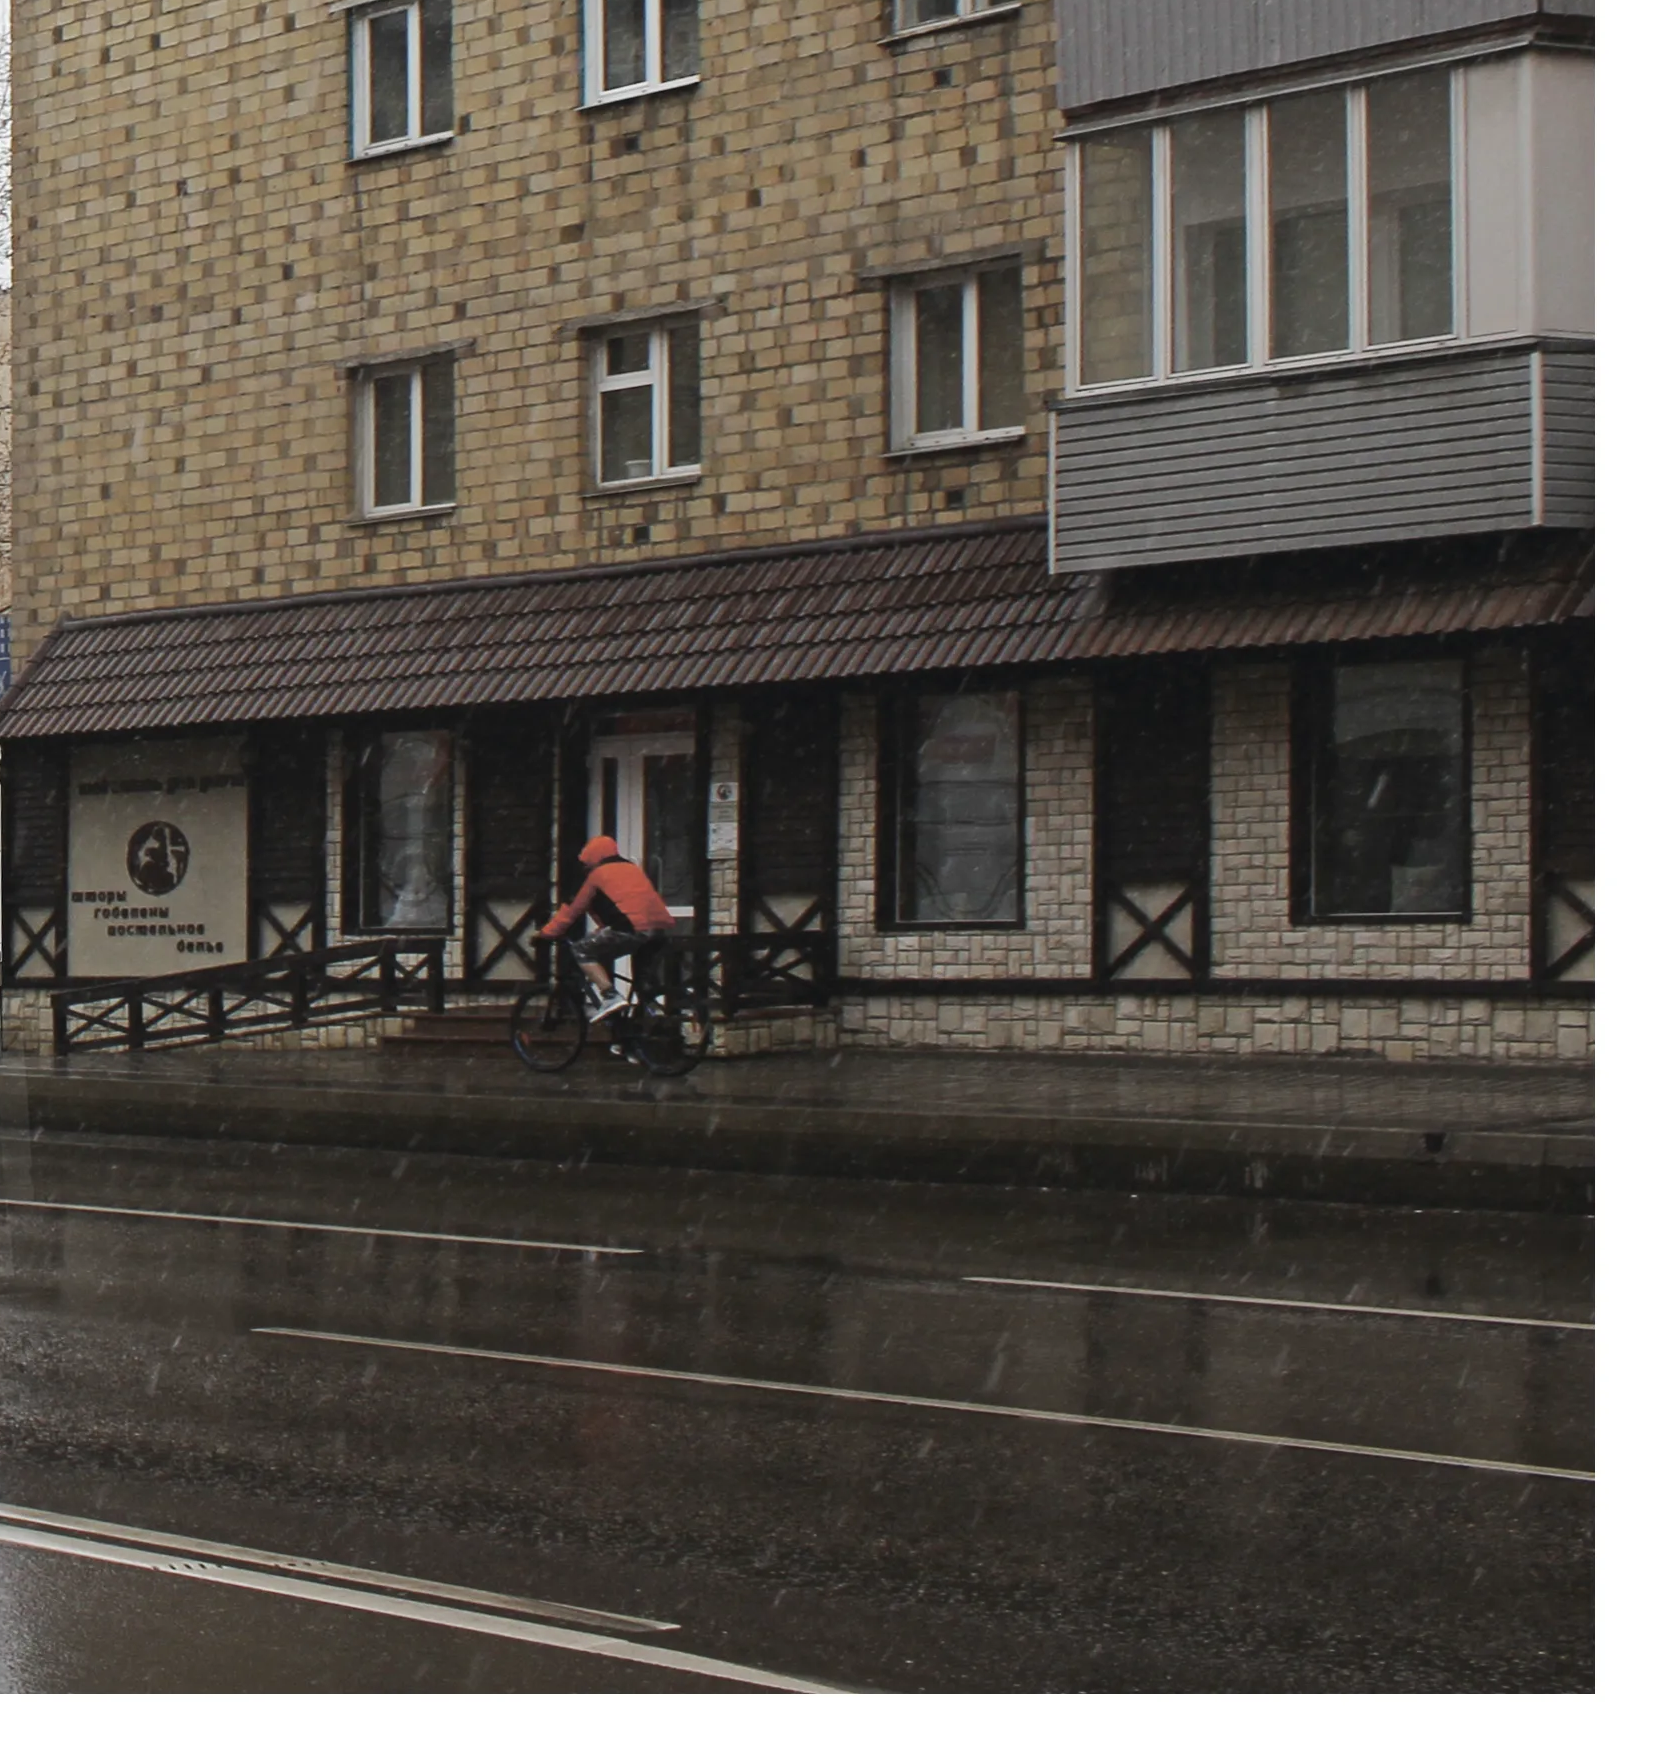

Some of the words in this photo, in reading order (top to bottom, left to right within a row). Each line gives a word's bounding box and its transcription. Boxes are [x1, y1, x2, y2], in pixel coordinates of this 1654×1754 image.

[71, 890, 127, 904] шторы
[94, 906, 169, 919] гобелены
[107, 923, 205, 937] постельное
